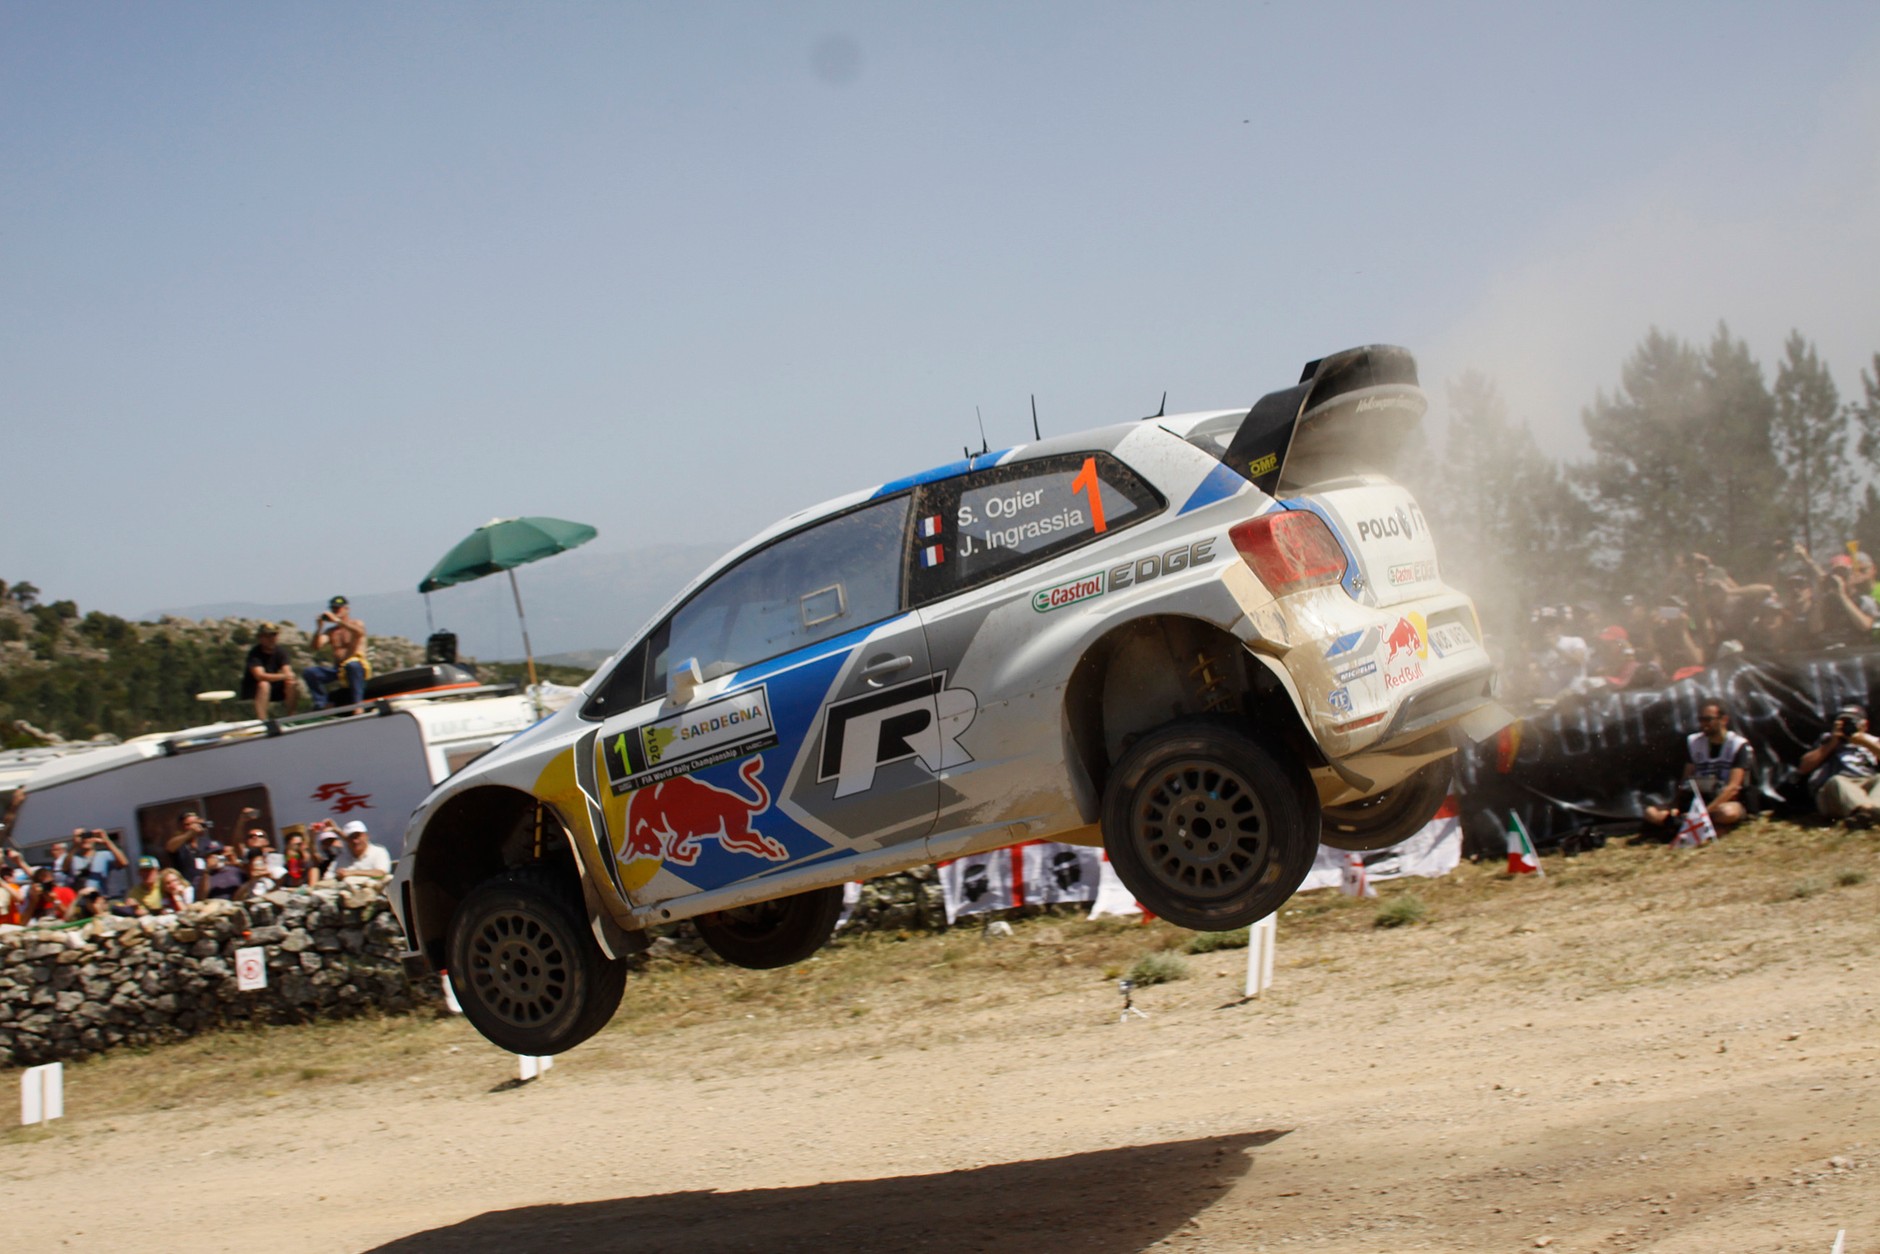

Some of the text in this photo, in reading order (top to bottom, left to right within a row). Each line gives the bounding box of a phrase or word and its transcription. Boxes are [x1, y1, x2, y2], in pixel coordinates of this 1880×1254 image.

[1250, 455, 1278, 476] OMP
[957, 489, 1044, 527] S. Ogier
[1071, 457, 1108, 533] 1
[959, 506, 1084, 557] J. Ingrassia
[1357, 516, 1399, 542] POLO
[1050, 537, 1217, 606] Castrol EDGE
[680, 705, 762, 741] SARDEGNA
[613, 733, 632, 775] 1
[646, 727, 661, 762] 2014
[641, 749, 737, 785] FIA World Rally Championship
